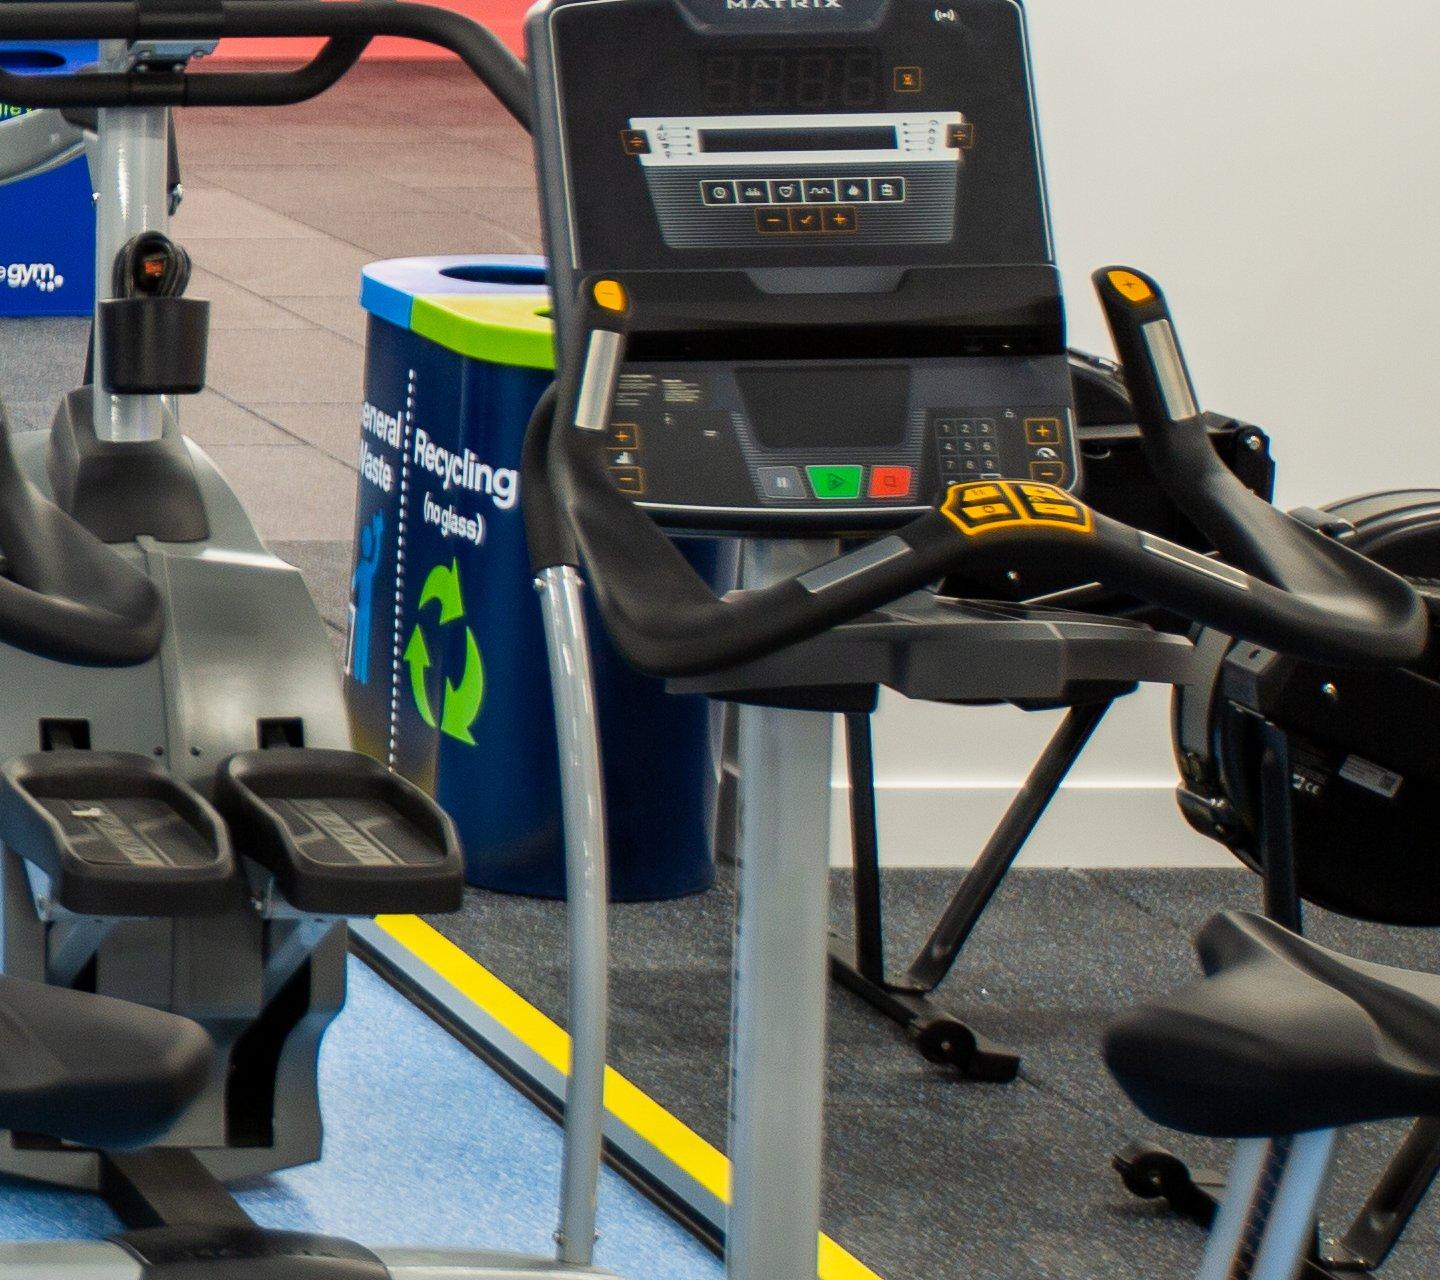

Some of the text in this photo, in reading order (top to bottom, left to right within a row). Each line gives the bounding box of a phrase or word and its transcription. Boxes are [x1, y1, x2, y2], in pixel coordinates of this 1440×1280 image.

[361, 400, 403, 450] eneral
[414, 427, 520, 510] Recycling
[441, 504, 487, 546] glass)
